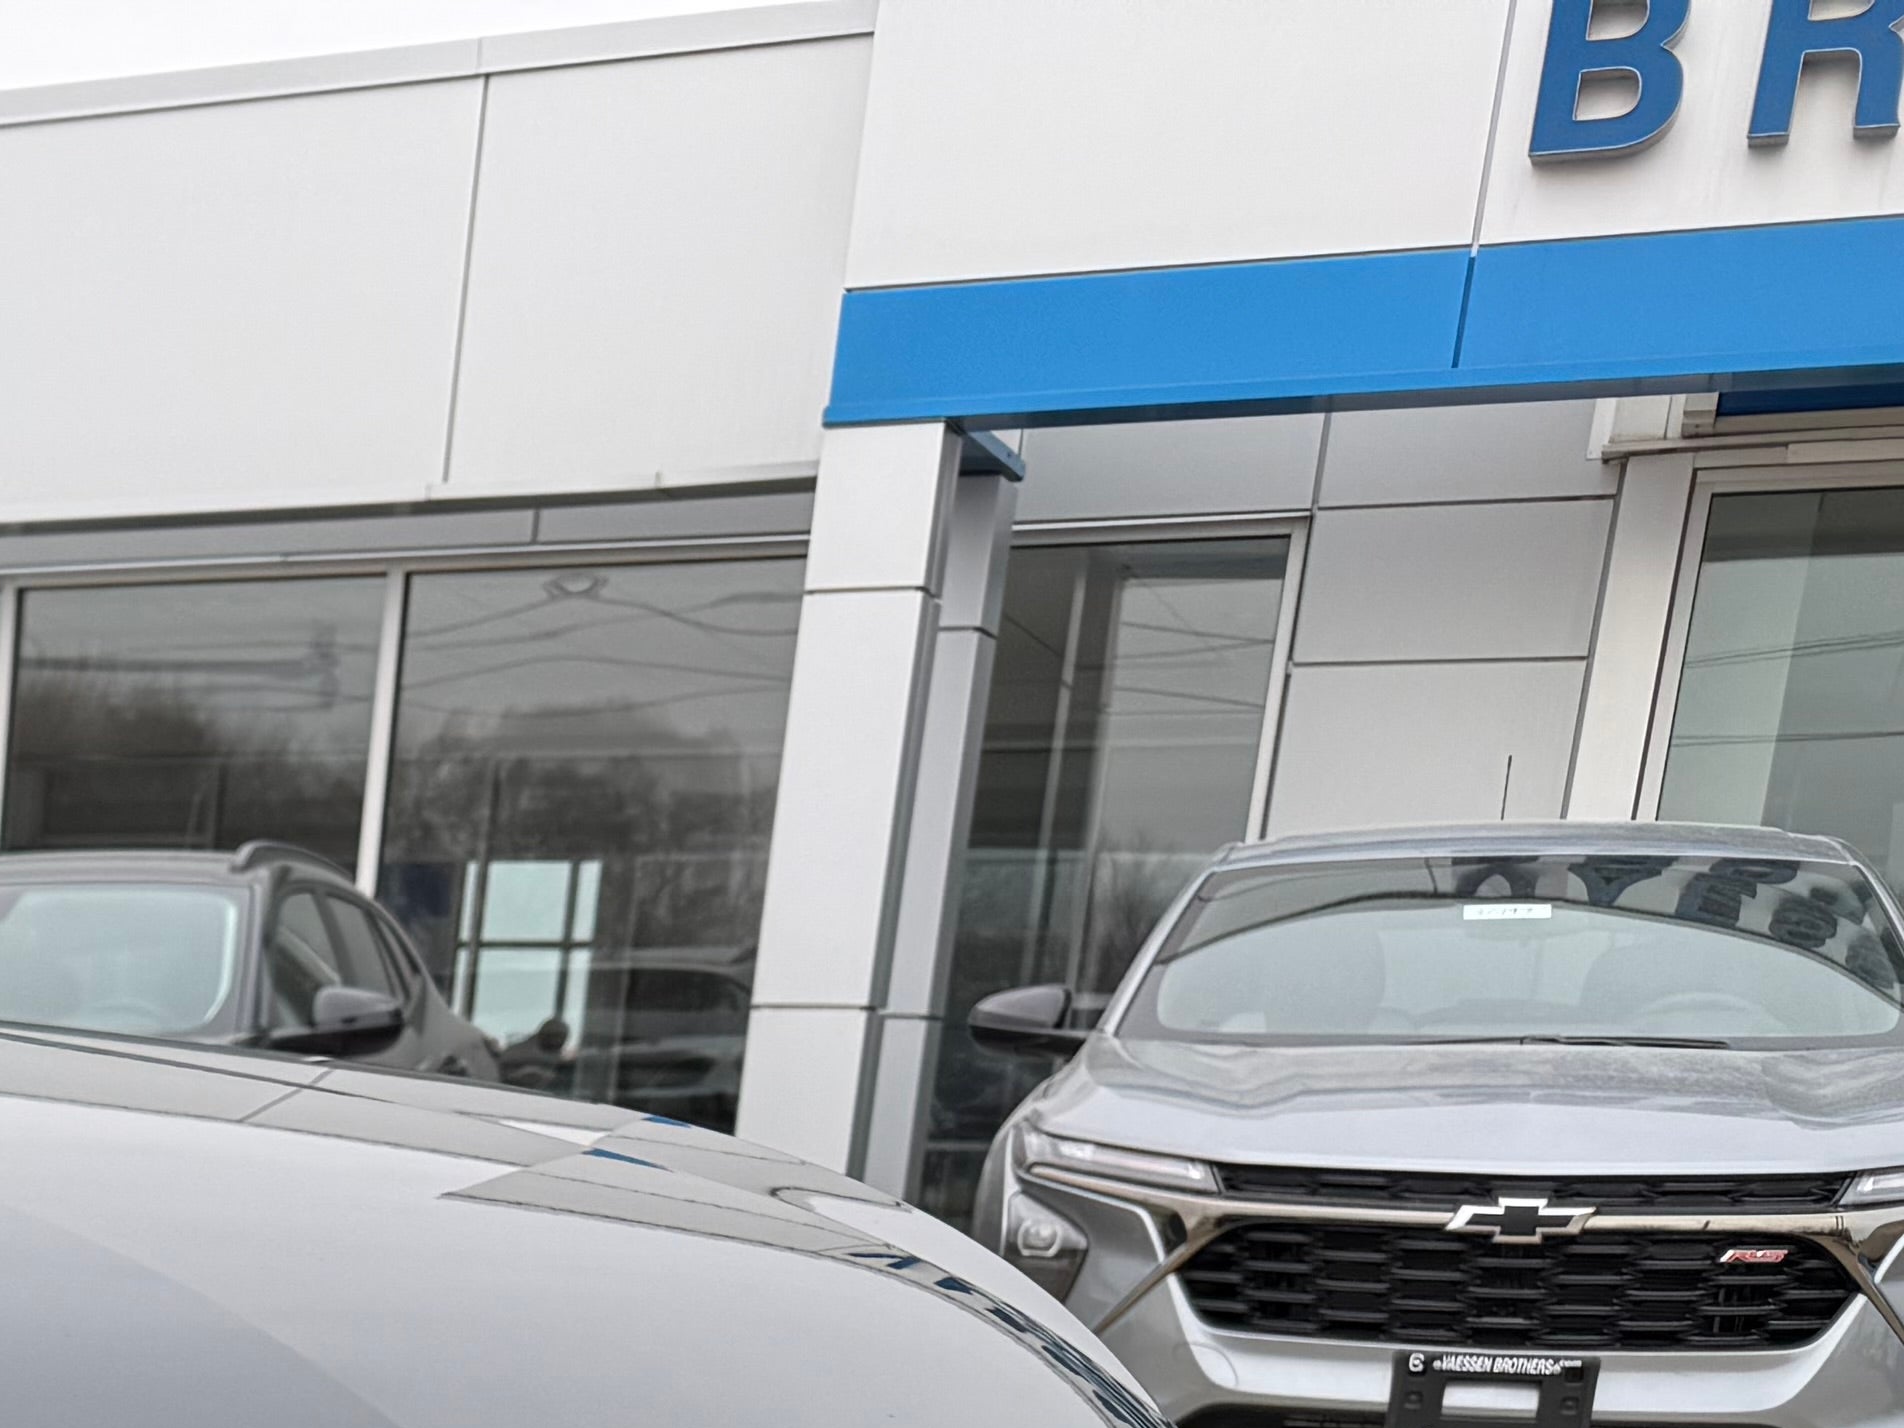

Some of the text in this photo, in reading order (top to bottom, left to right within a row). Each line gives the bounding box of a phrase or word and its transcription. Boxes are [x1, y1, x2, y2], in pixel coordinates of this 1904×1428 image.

[1528, 0, 1904, 162] BR
[1719, 1249, 1789, 1264] RS
[1493, 1356, 1556, 1375] BROTHERS
